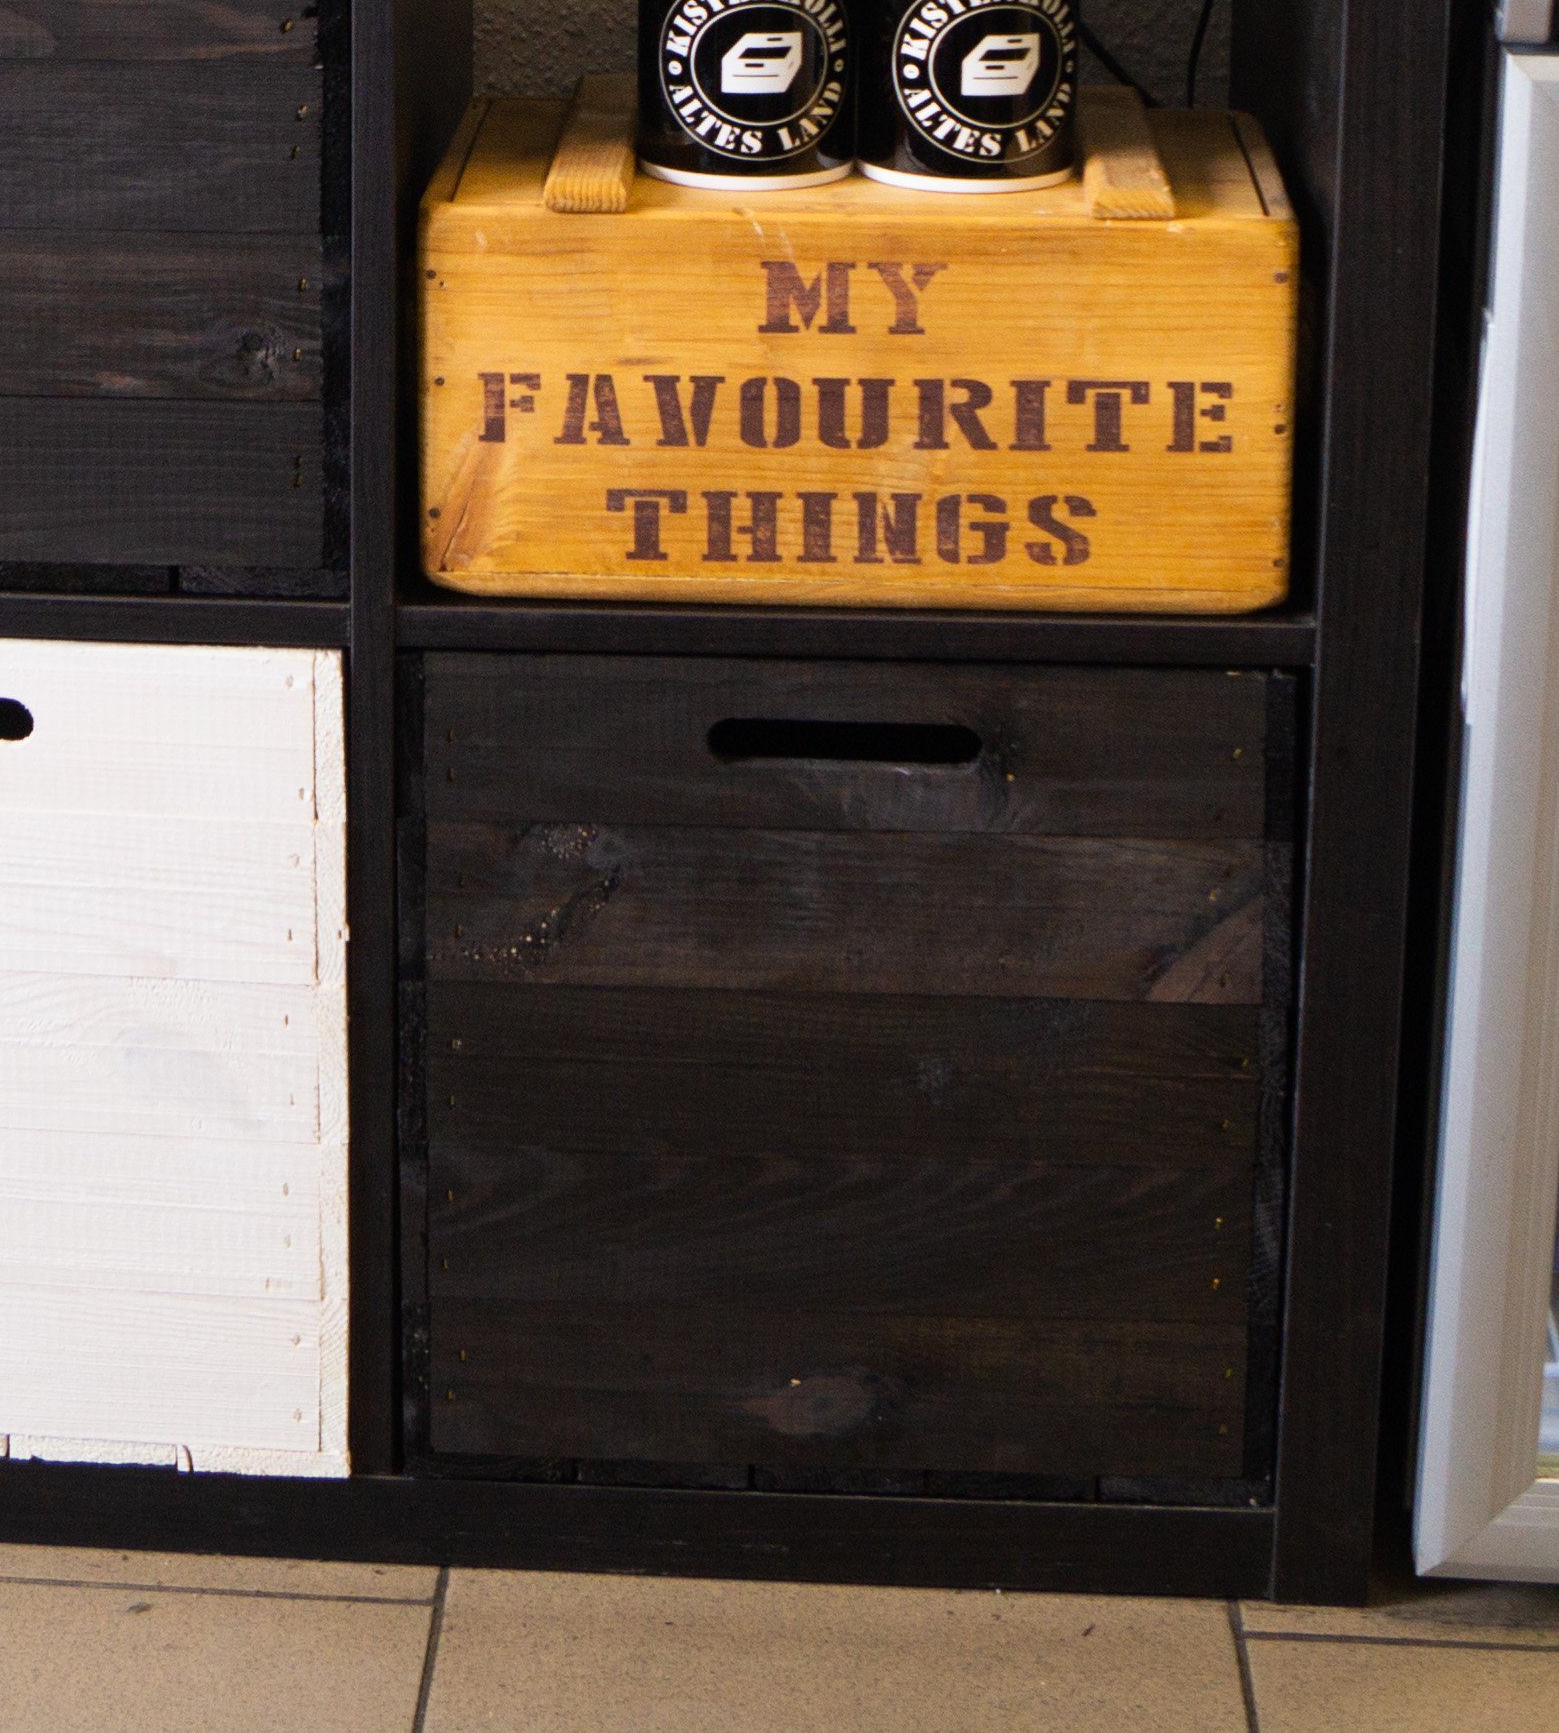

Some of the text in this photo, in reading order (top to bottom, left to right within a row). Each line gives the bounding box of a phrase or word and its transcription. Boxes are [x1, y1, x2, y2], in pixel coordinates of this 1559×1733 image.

[669, 81, 842, 155] ALTES LAND
[902, 82, 1073, 157] ALTES LAND
[757, 260, 948, 336] MY
[477, 372, 1235, 454] FAVOURITE
[605, 488, 1099, 566] THINGS
